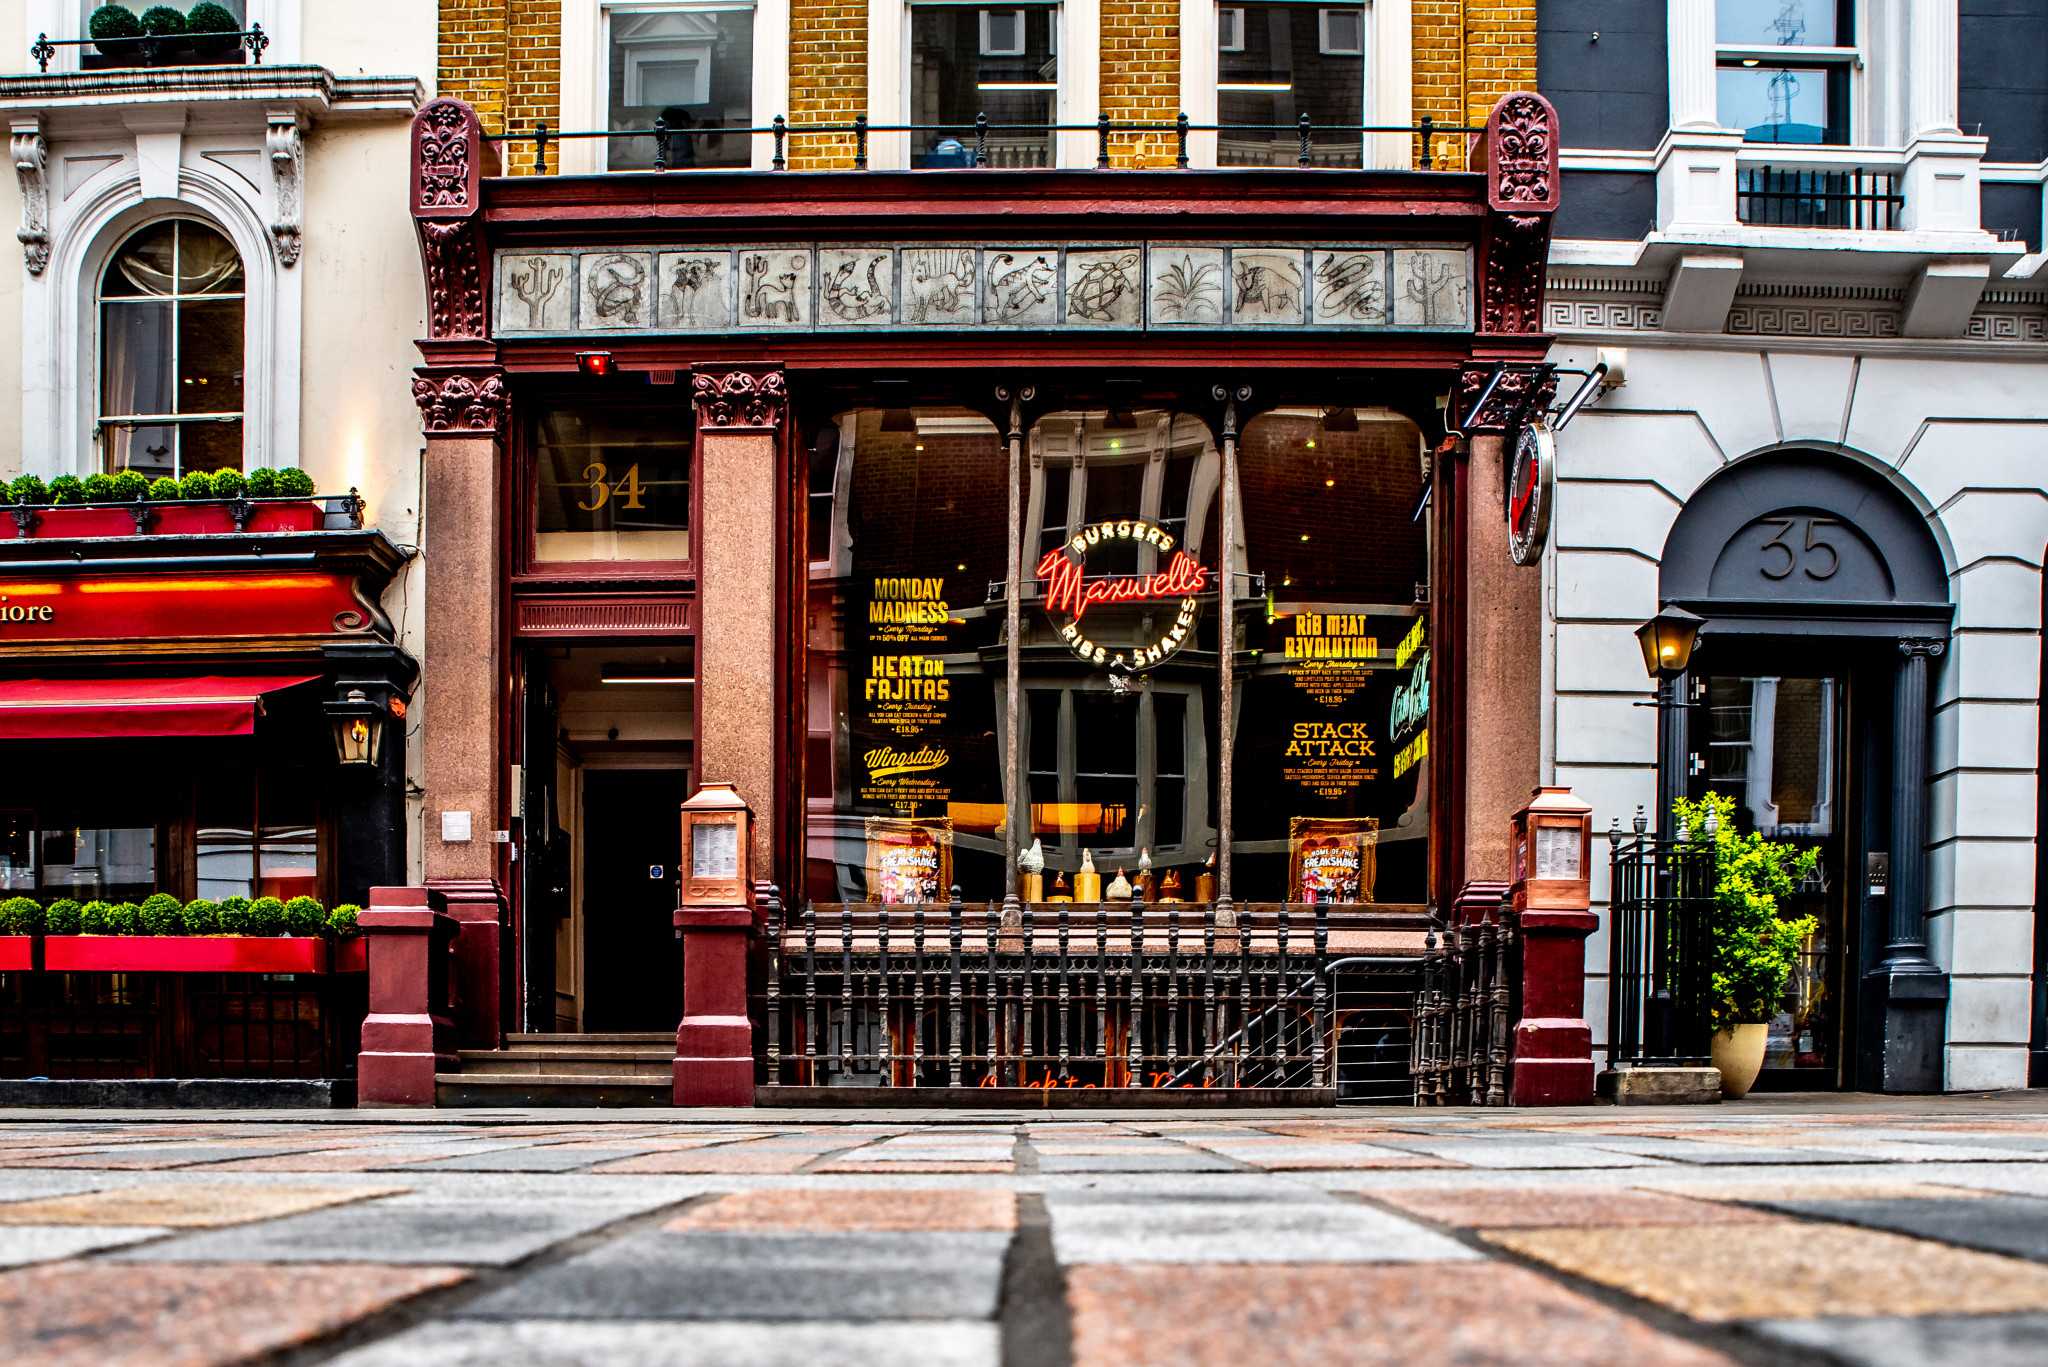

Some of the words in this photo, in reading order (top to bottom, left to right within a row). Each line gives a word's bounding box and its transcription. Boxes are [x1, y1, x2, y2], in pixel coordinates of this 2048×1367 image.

[578, 462, 646, 511] 34
[1071, 520, 1177, 554] BURGERS
[1760, 516, 1841, 581] 35
[874, 578, 944, 600] MONDAY
[1037, 551, 1208, 619] Maxwell's
[870, 601, 949, 624] MADNESS
[884, 625, 904, 634] Every
[906, 625, 934, 634] Monday
[1062, 623, 1106, 664] RIBS
[1133, 598, 1197, 667] SHAKES
[1326, 615, 1366, 636] MEAT
[897, 634, 910, 642] OFF
[1284, 637, 1378, 658] REVOLUTION
[872, 656, 924, 677] HEAT
[1304, 660, 1324, 670] Every
[1326, 660, 1358, 670] Thursday
[866, 679, 950, 700] FAJITAS
[883, 702, 902, 711] Every
[905, 702, 933, 711] Tuesday
[1293, 722, 1368, 738] STACK
[864, 745, 950, 771] Wingsday
[1284, 740, 1376, 756] ATTACK
[1308, 758, 1327, 768] Every
[1330, 758, 1354, 768] Friday
[877, 778, 896, 787] Every
[898, 778, 936, 787] Wednesday
[882, 856, 938, 868] FREAKSHAKE
[1304, 857, 1360, 869] FREAKSHAKE
[1312, 848, 1329, 857] HOME
